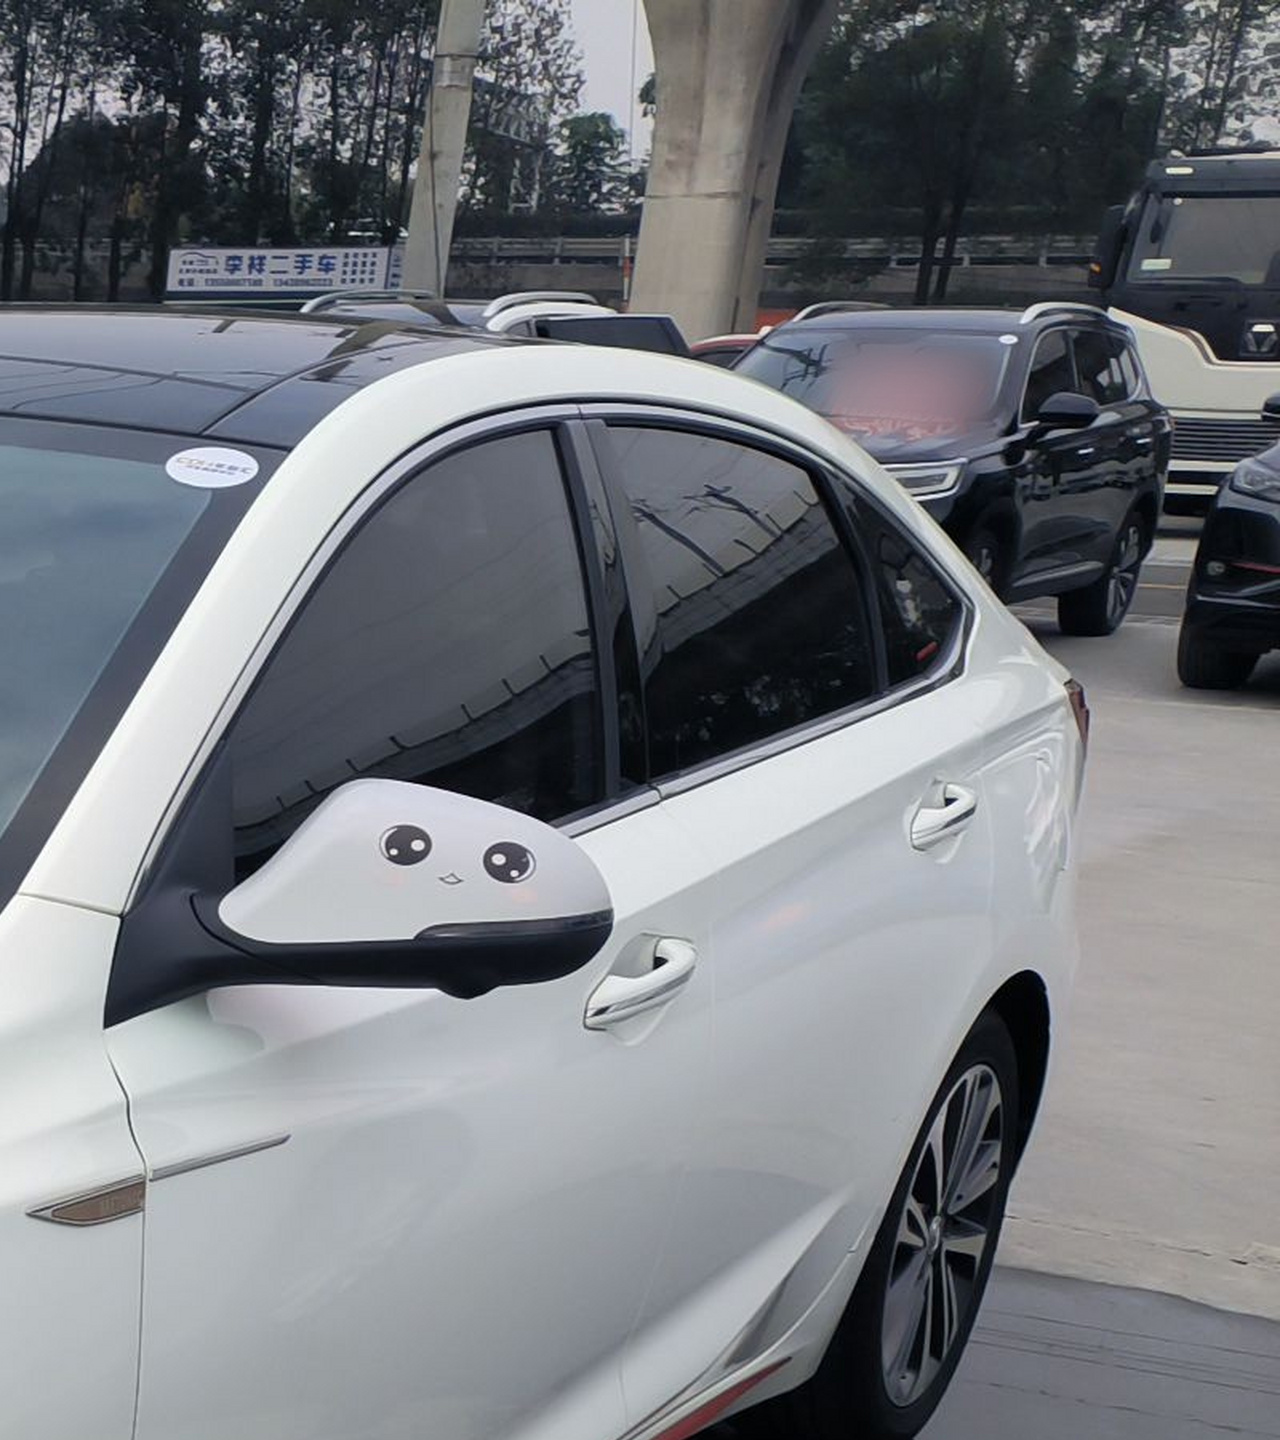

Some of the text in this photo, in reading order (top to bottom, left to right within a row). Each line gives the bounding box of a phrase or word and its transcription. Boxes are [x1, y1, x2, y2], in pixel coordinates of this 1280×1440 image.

[224, 254, 337, 275] 李祥二手车
